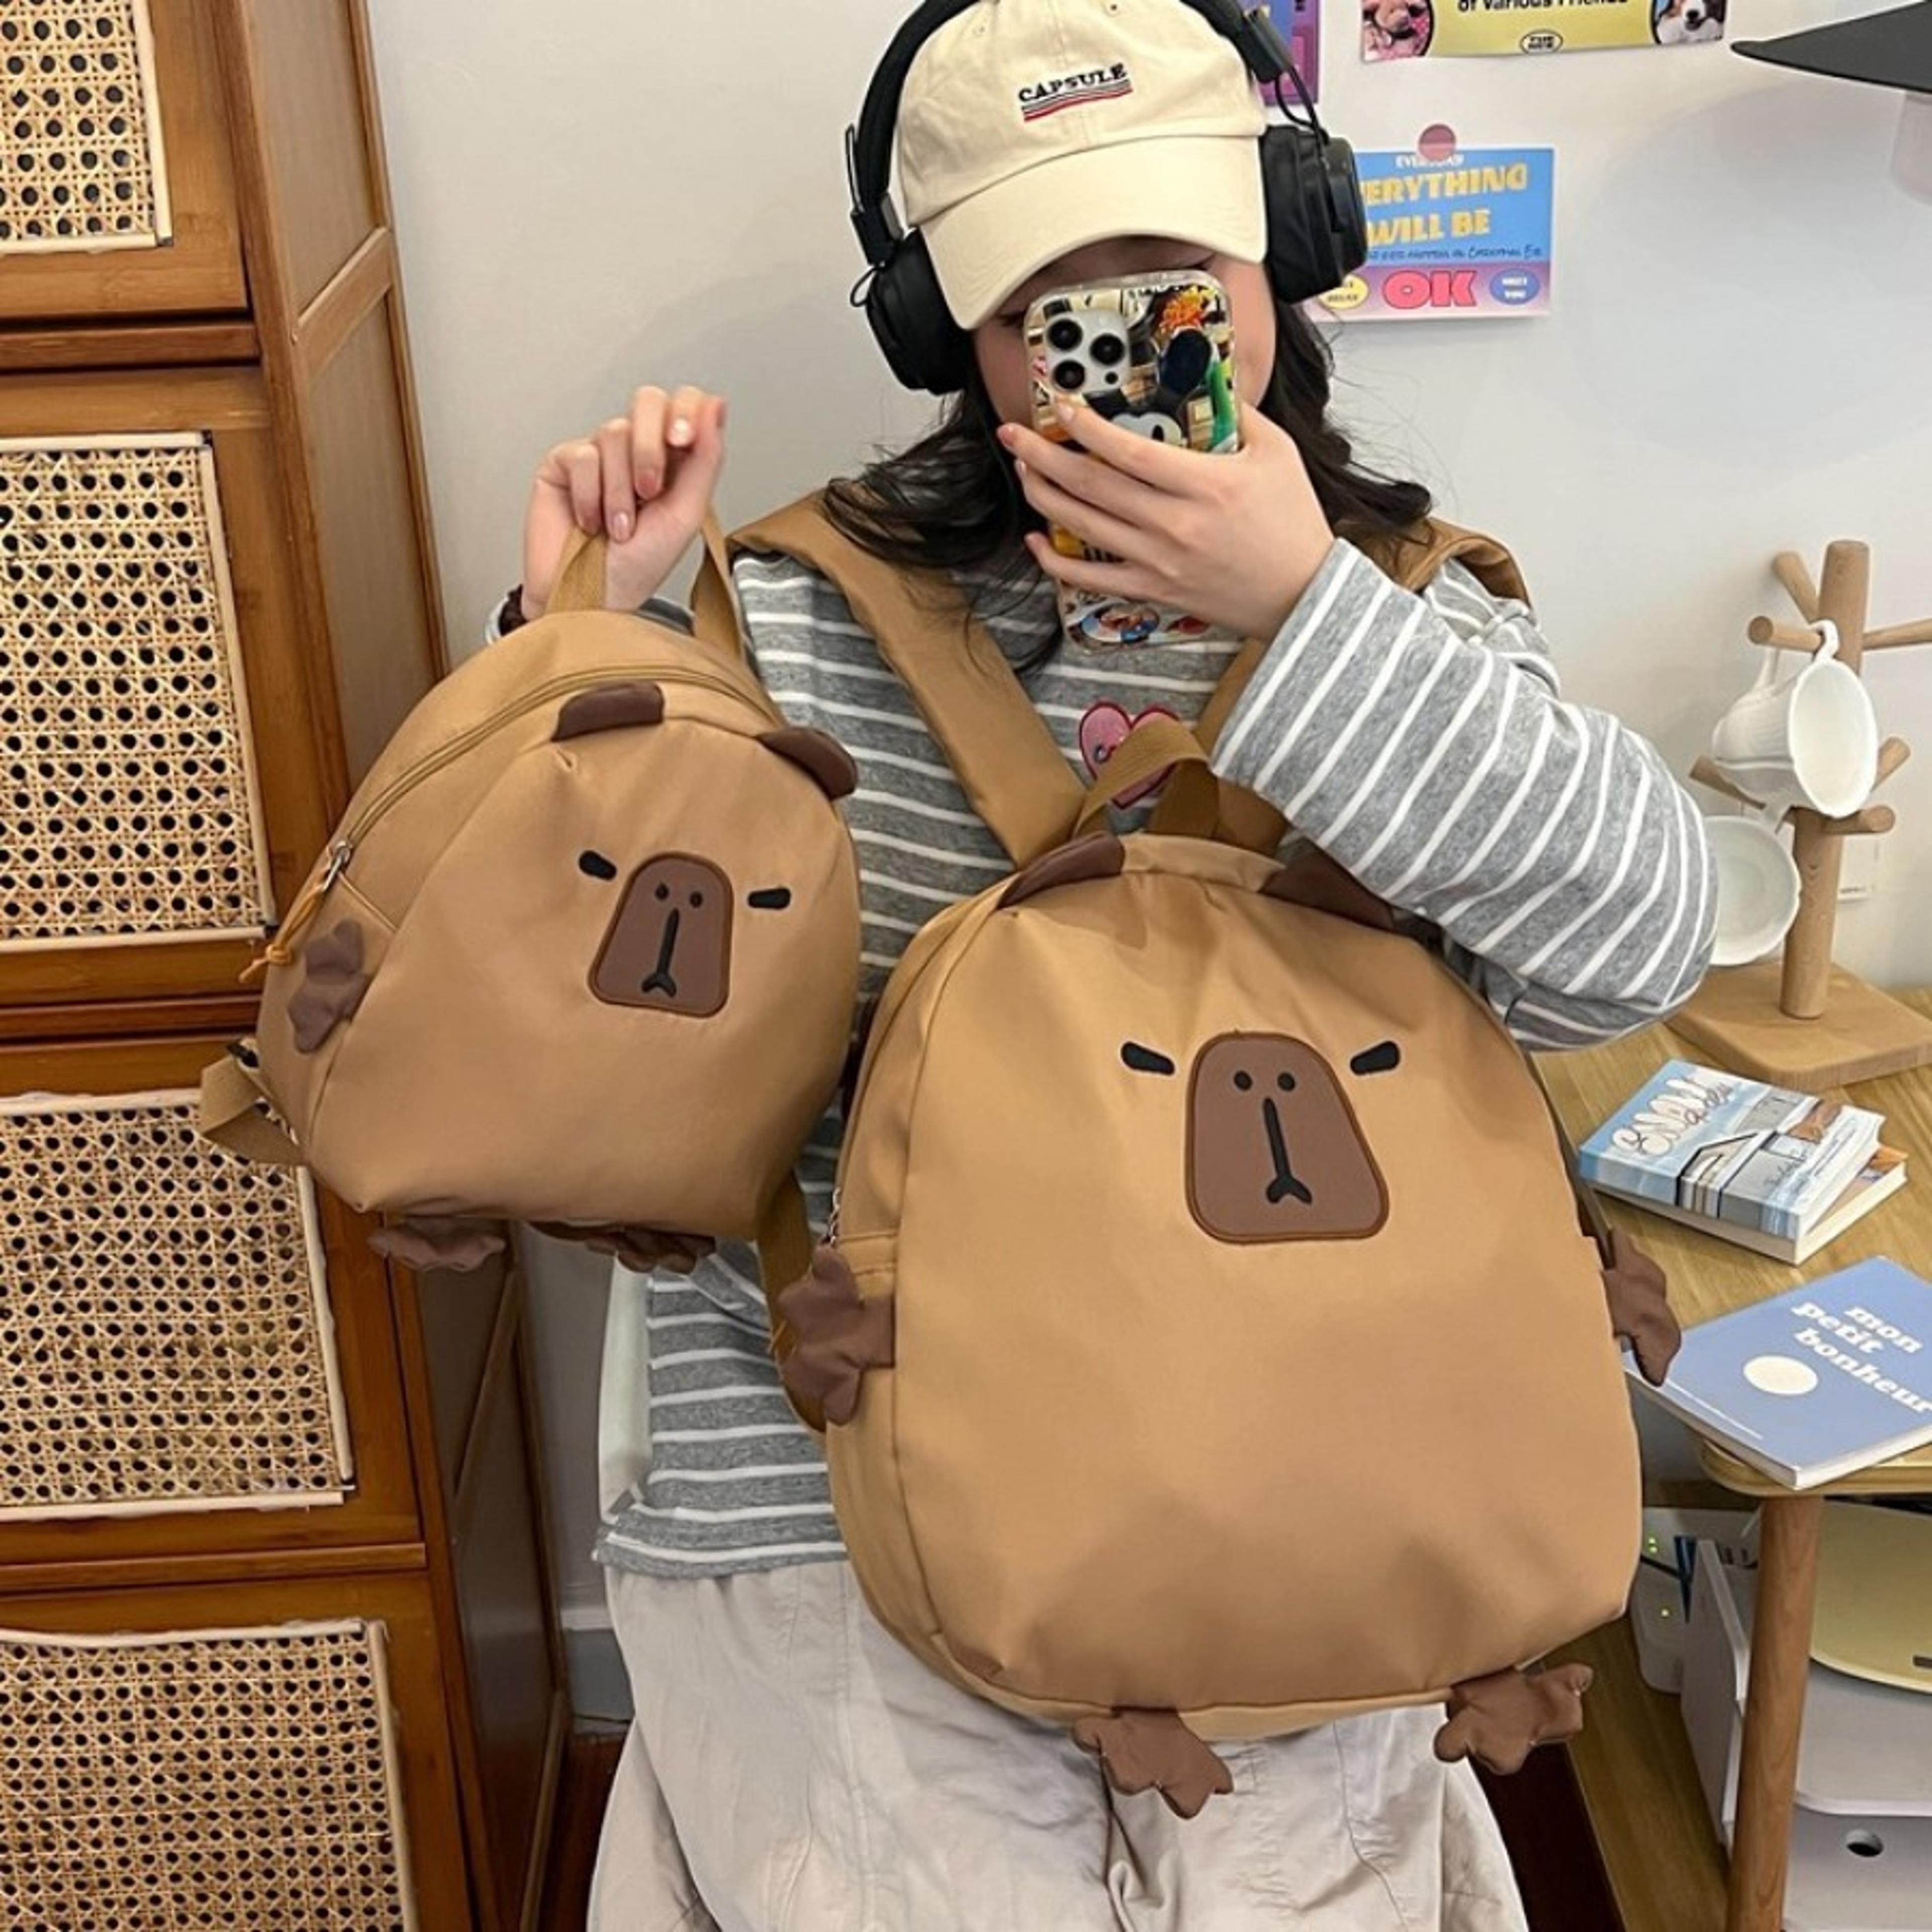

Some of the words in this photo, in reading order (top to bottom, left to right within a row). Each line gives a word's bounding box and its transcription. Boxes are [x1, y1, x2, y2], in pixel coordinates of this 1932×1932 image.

[1018, 62, 1128, 102] CAPSULE
[1360, 163, 1528, 207] ERYTHING
[1366, 213, 1444, 248] WILL
[1451, 208, 1491, 238] BE
[1383, 270, 1477, 309] OK
[1790, 1302, 1885, 1353] petit
[1843, 1306, 1923, 1353] mon
[1794, 1327, 1932, 1413] bonheur
